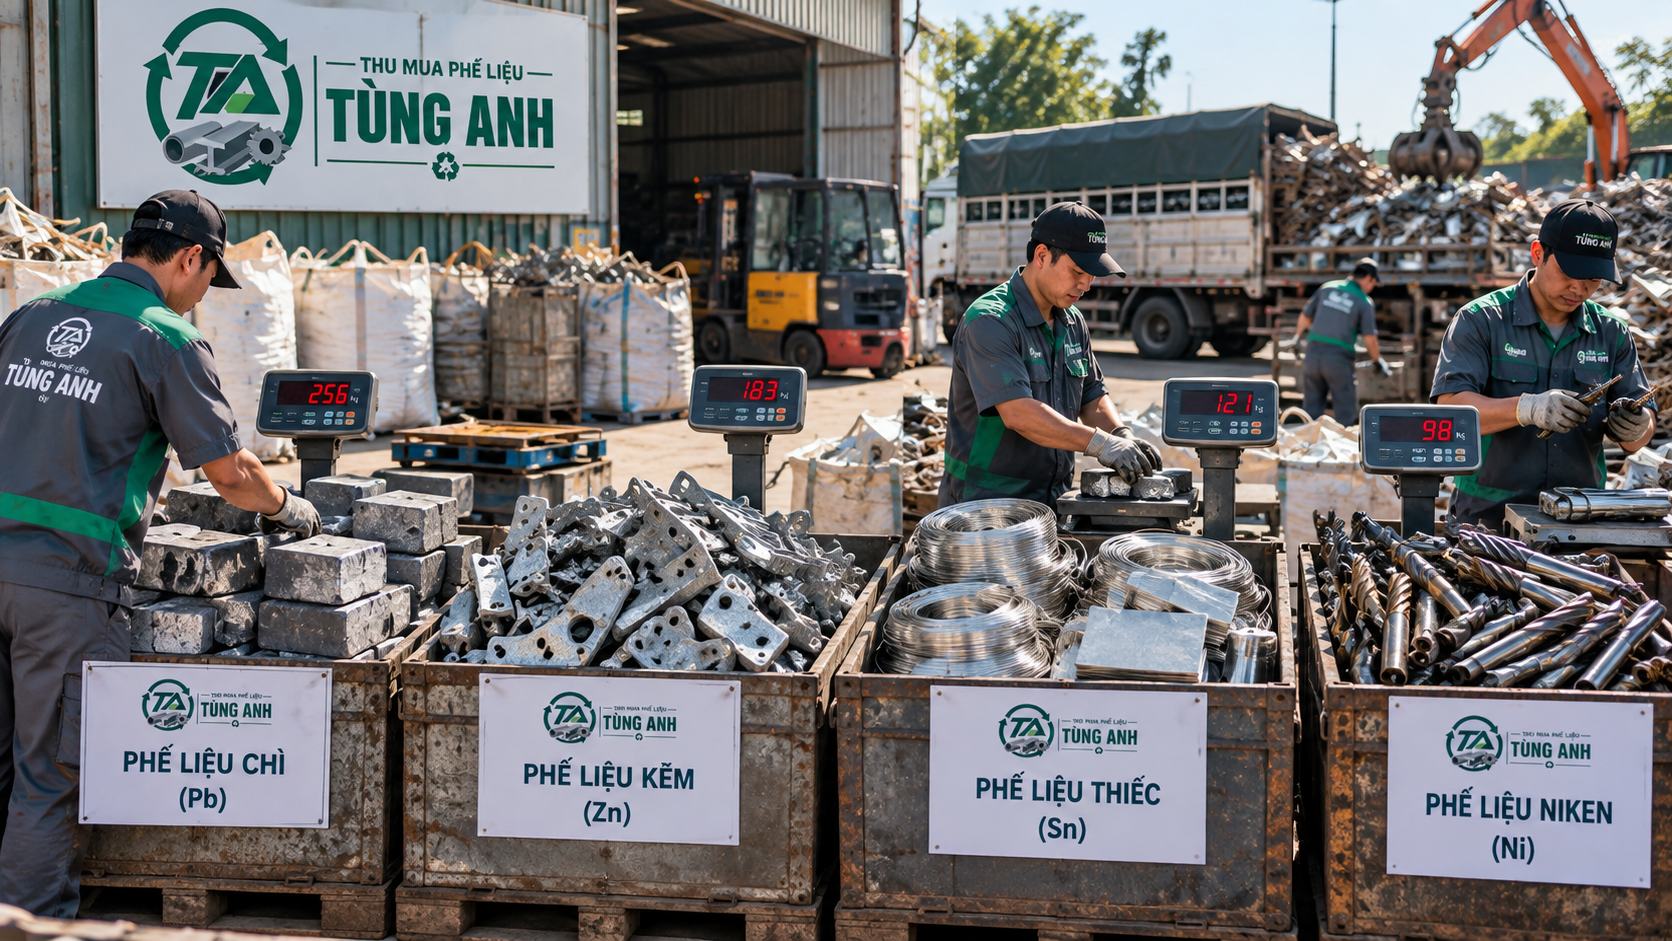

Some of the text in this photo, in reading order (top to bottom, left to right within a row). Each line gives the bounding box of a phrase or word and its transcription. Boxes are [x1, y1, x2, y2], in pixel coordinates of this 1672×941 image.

[360, 57, 523, 85] THU MUA PHẾ LIỆU
[326, 77, 554, 149] TÙNG ANH
[54, 373, 102, 404] ANH
[308, 384, 349, 404] 256
[743, 380, 778, 400] 183
[1217, 393, 1252, 413] 121
[1422, 420, 1452, 440] 98
[201, 700, 272, 719] TÙNG ANH
[603, 712, 677, 732] TÙNG ANH
[1062, 726, 1138, 745] TÙNG ANH
[1510, 739, 1591, 760] TÙNG ANH
[123, 743, 285, 779] PHẾ LIỆU CHÌ
[523, 757, 694, 792] PHẾ LIỆU KẼM
[179, 786, 227, 814] (Pb)
[976, 771, 1161, 808] PHẾ LIỆU THIẾC
[583, 800, 631, 828] (Zn)
[1426, 786, 1613, 825] PHẾ LIỆU NIKEN
[1038, 816, 1086, 844] (Sn)
[1492, 835, 1535, 865] (Ni)
